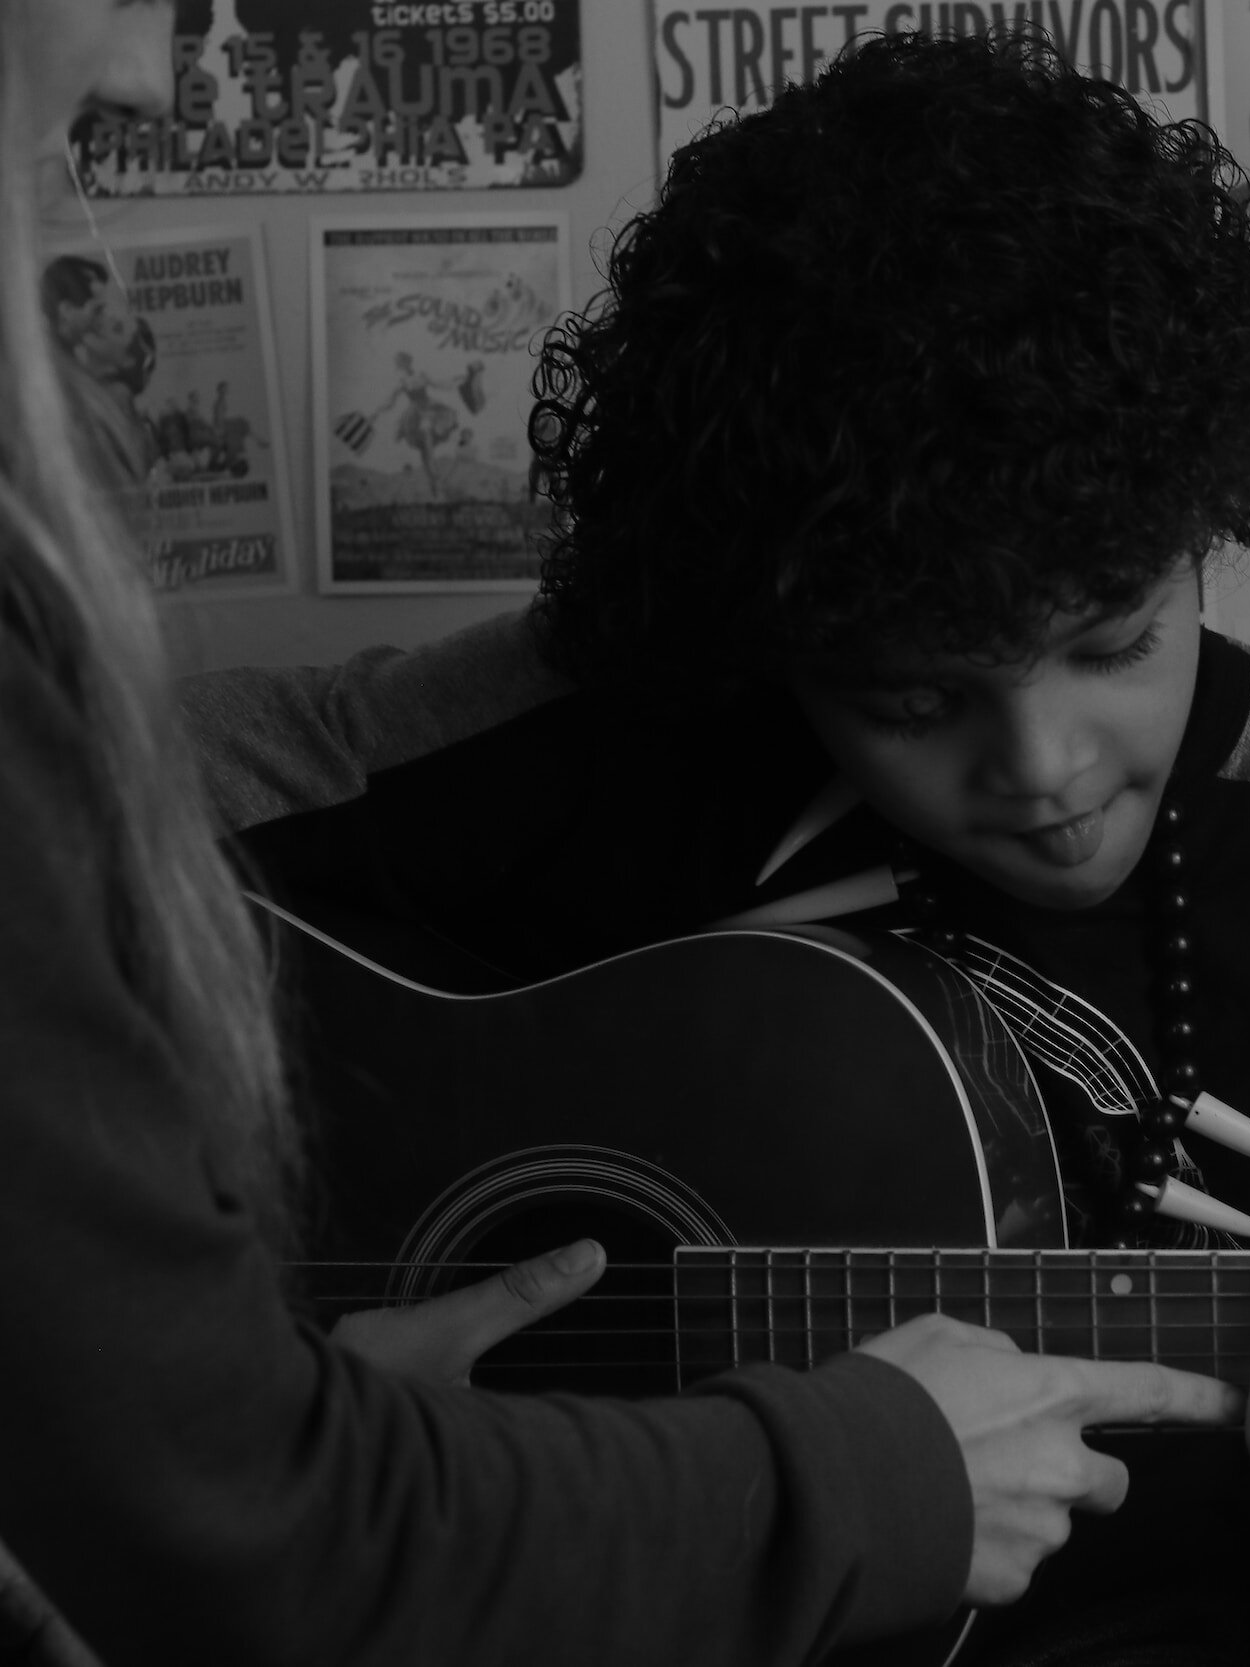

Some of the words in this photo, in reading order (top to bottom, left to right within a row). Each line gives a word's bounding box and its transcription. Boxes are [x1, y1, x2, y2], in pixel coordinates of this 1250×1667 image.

[372, 3, 475, 26] tickets
[483, 1, 555, 24] $5.00
[222, 33, 278, 72] 15
[352, 30, 406, 66] 16
[424, 27, 552, 66] 1968
[184, 172, 277, 190] ANDY
[135, 248, 231, 283] AUDREY
[127, 278, 243, 314] HEPBURN
